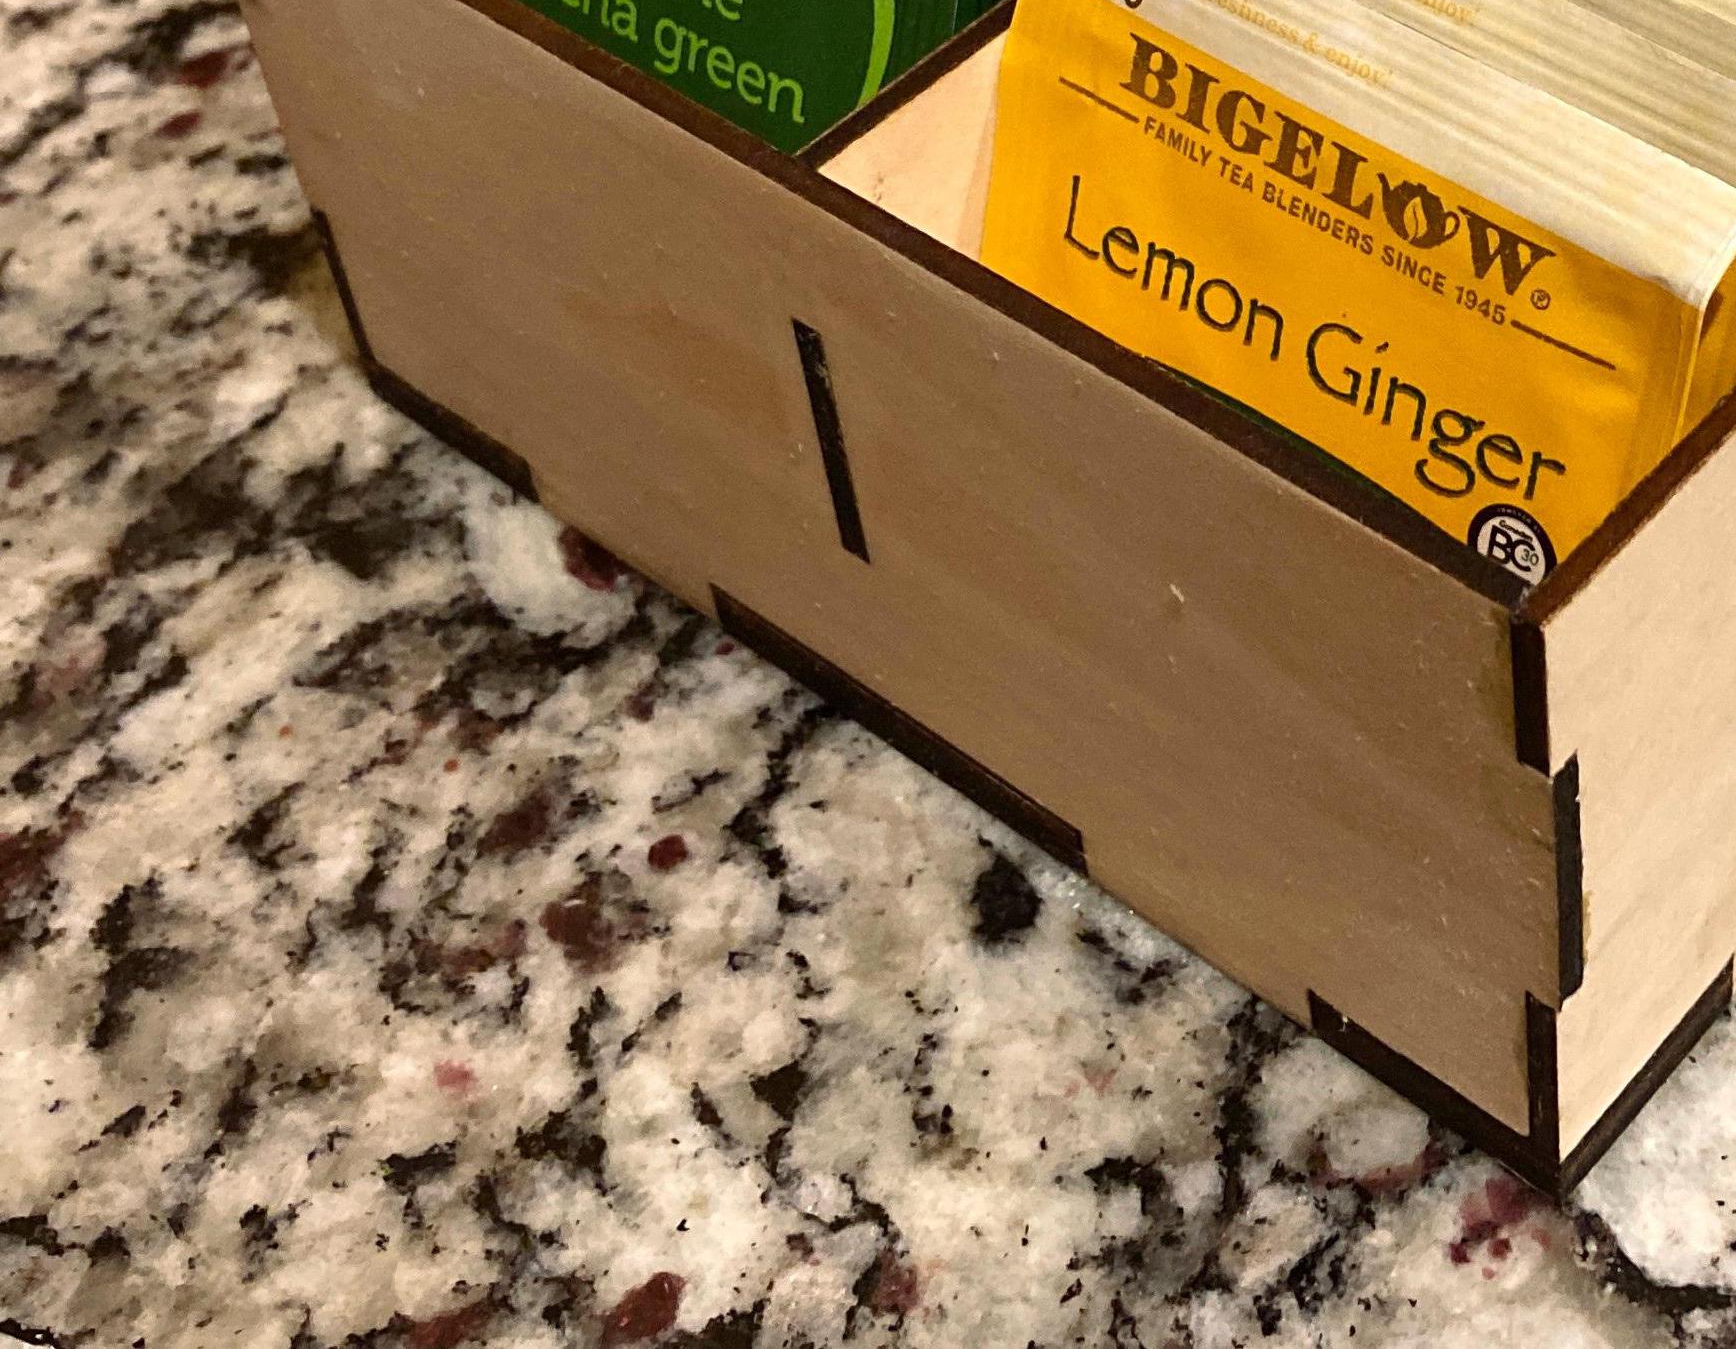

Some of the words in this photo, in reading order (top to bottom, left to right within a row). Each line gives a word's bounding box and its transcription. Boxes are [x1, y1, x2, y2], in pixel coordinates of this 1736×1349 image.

[654, 17, 806, 124] green
[1119, 31, 1557, 297] BIGELOW
[1062, 174, 1285, 361] Lemon
[1305, 320, 1567, 501] Ginger
[1143, 115, 1213, 167] FAMILY
[1218, 155, 1254, 194] TEA
[1261, 179, 1374, 254] BLENDERS
[1380, 242, 1446, 296] SINCE
[1454, 283, 1507, 327] 1945
